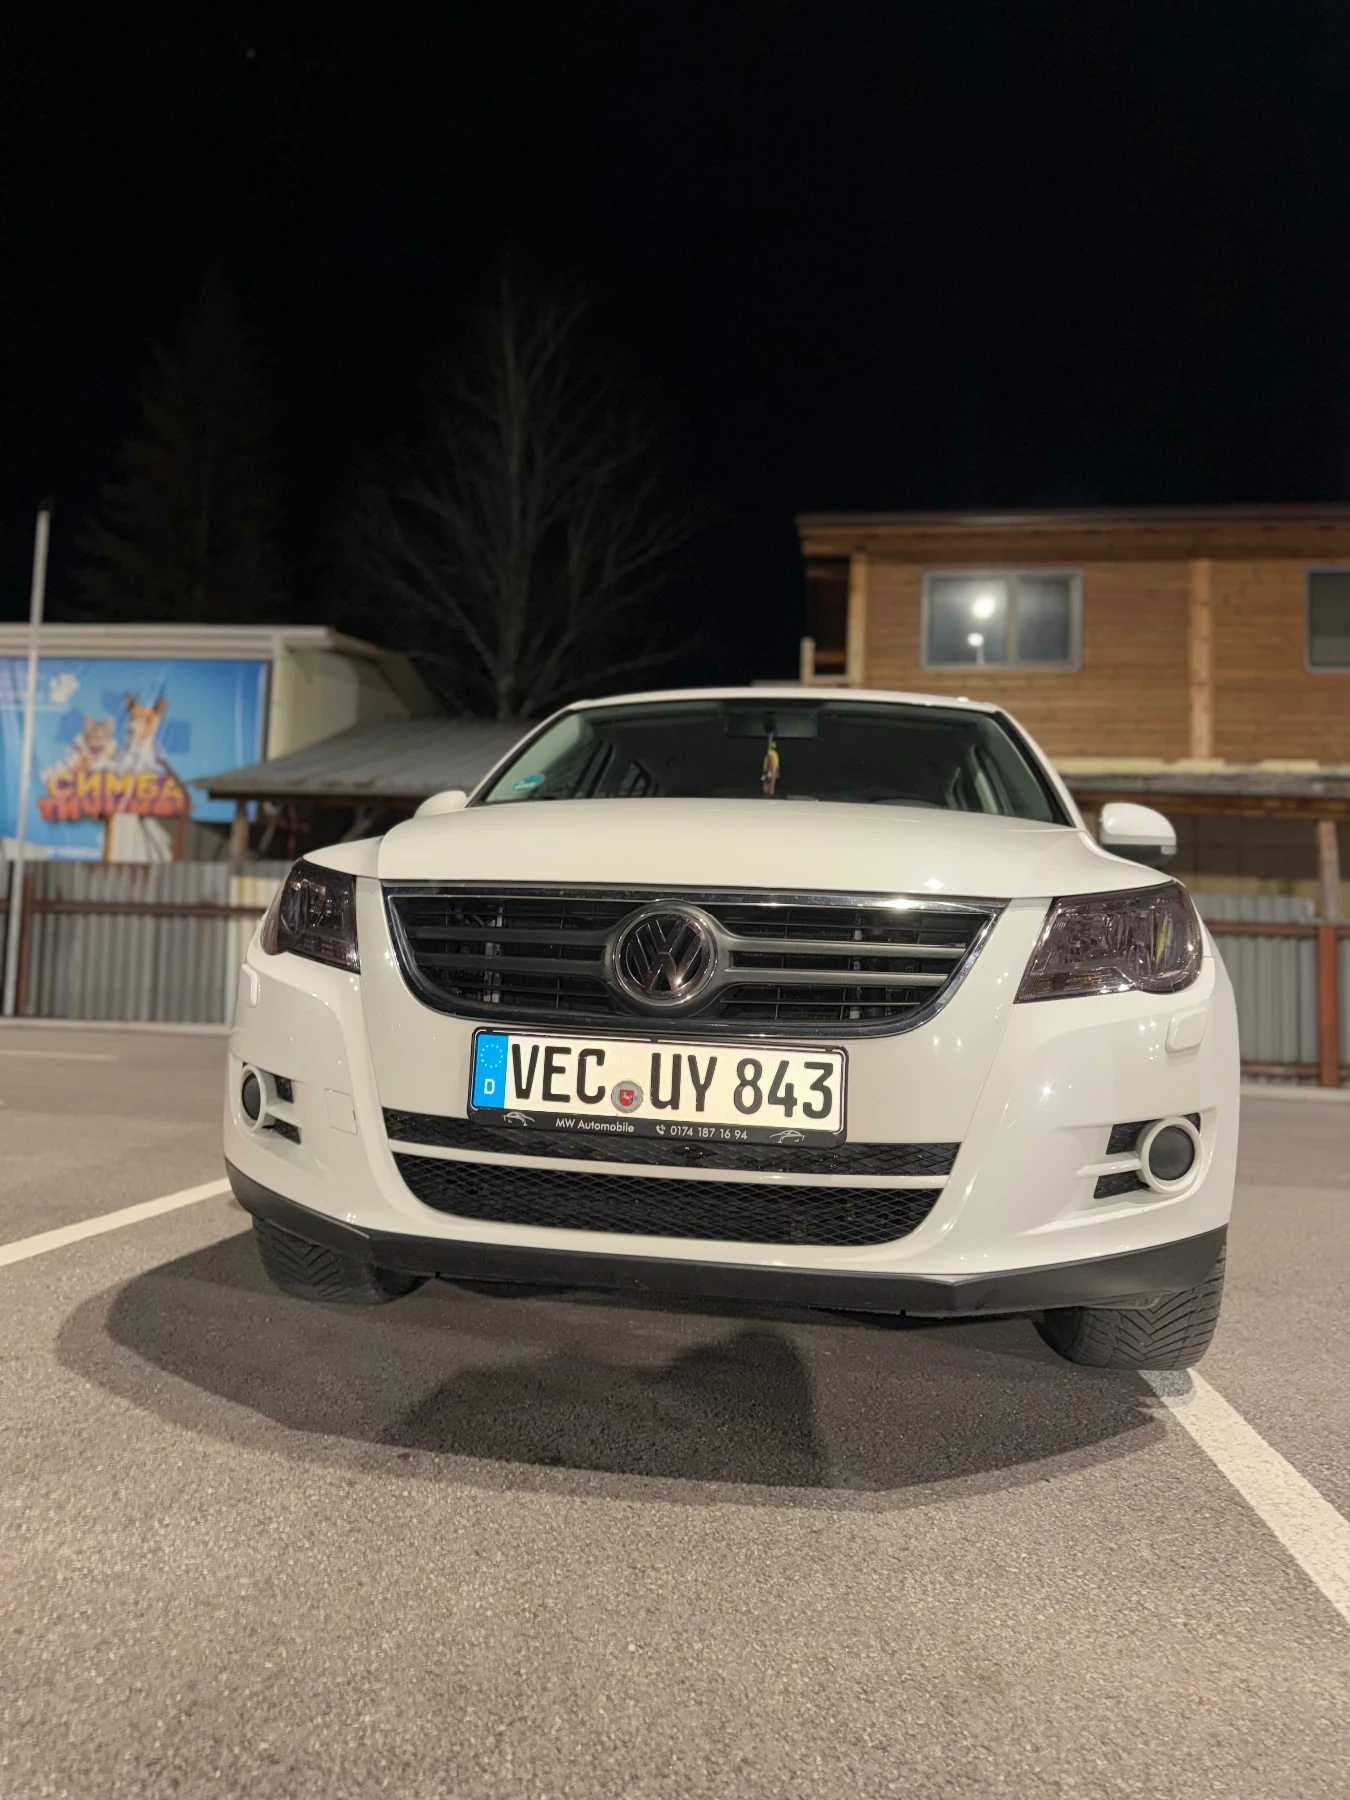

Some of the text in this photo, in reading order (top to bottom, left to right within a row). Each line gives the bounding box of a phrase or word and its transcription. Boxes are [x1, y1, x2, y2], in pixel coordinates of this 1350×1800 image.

[484, 1079, 495, 1095] D
[511, 1043, 834, 1119] VEC UY 843
[555, 1118, 635, 1133] MW Automobile
[670, 1125, 748, 1141] 0174 187 16 94
